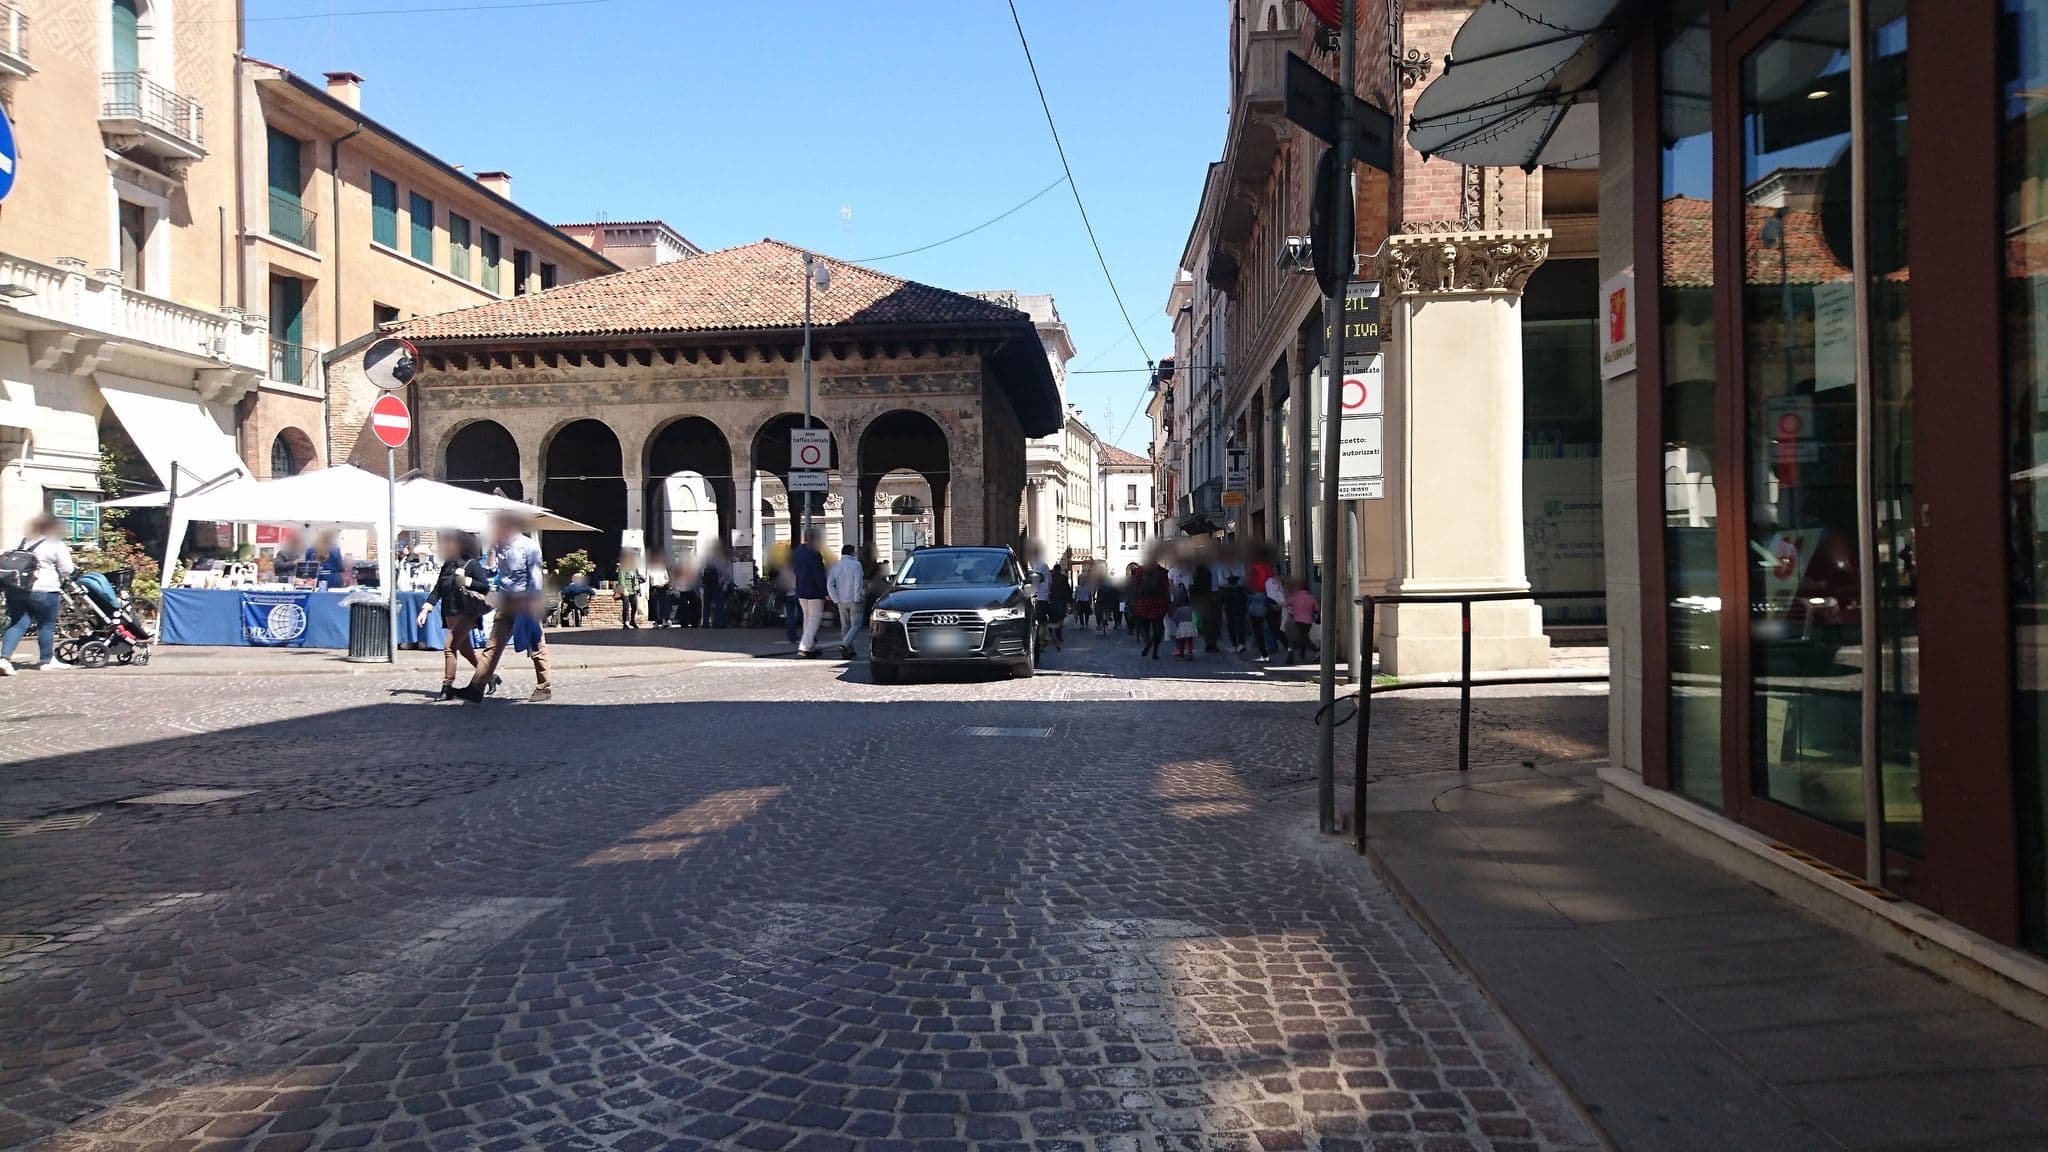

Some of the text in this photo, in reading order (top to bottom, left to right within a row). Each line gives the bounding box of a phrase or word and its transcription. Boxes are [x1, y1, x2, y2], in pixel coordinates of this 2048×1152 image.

[1345, 296, 1369, 311] ZTL
[1326, 323, 1378, 339] ATIVA
[1342, 448, 1380, 456] autorizzati
